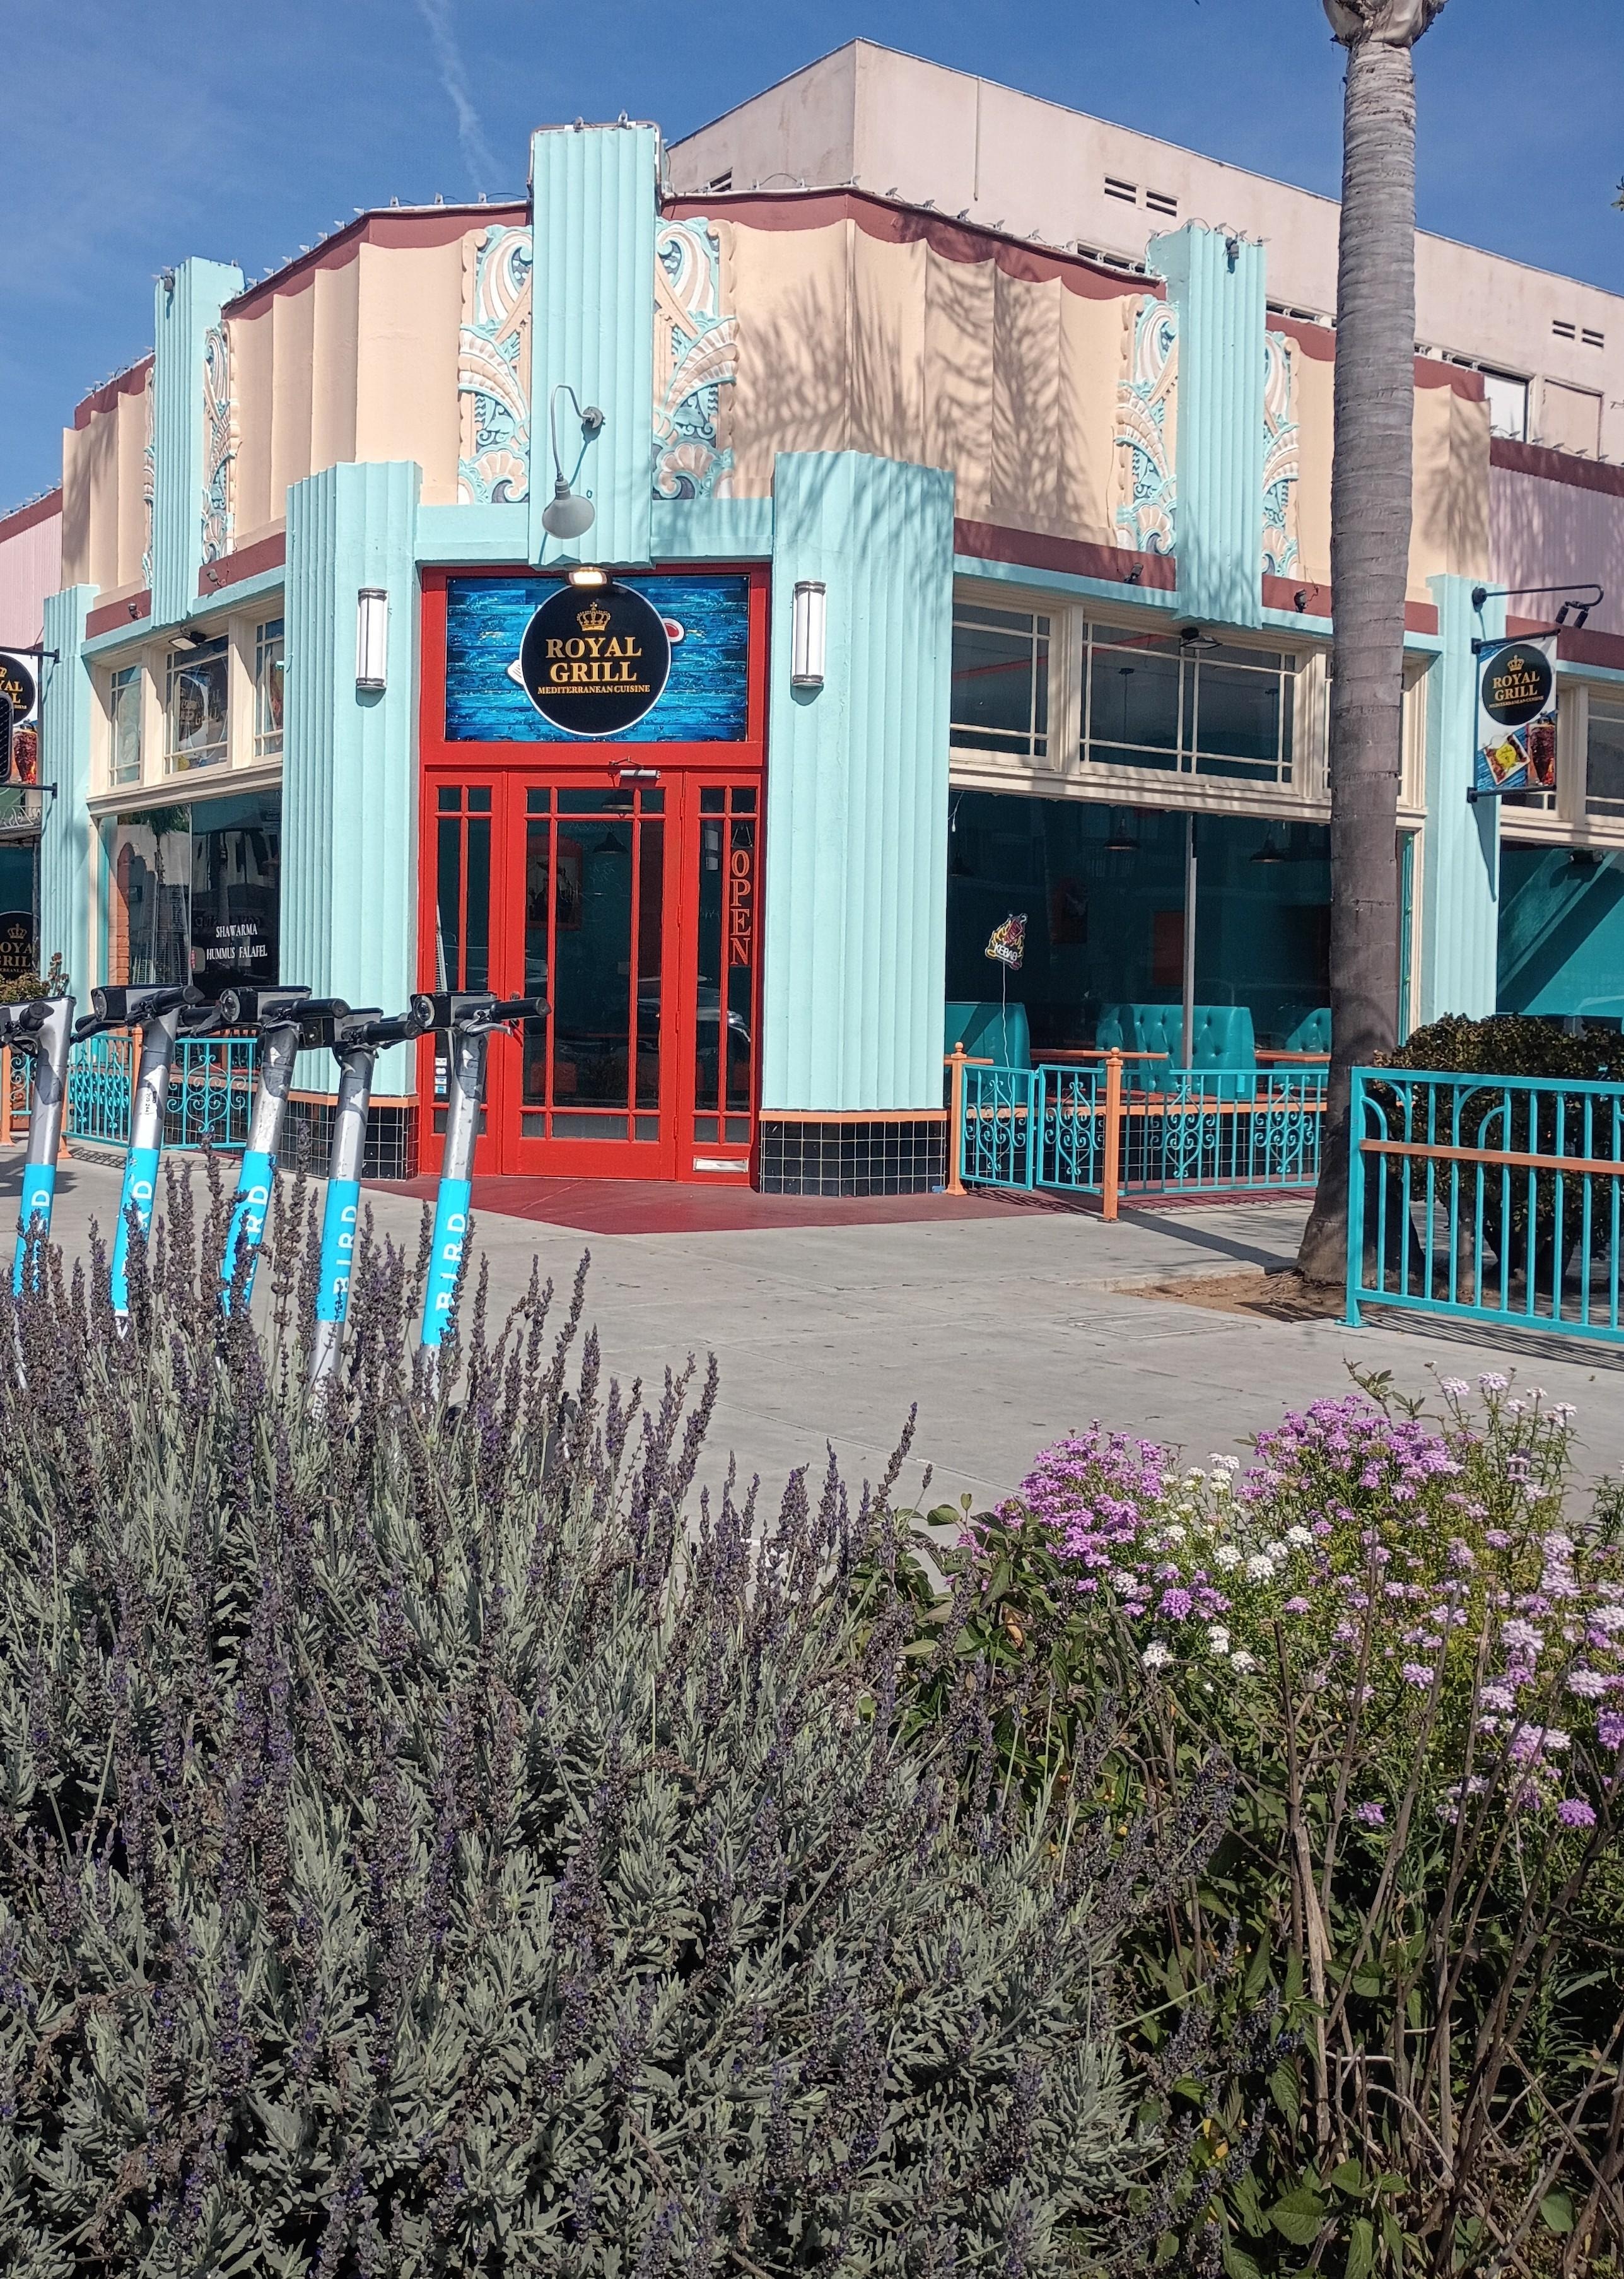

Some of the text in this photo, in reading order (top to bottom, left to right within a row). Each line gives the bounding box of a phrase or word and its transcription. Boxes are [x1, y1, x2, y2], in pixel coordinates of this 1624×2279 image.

[546, 636, 642, 658] ROYAL
[550, 662, 637, 683] GRILL
[1492, 671, 1540, 689] ROYAL
[0, 680, 23, 692] YAL
[538, 684, 650, 694] MEDITERRANEAN CUISINE
[1495, 684, 1538, 701] GRILL
[730, 850, 751, 965] OPEN
[216, 923, 258, 938] SHAWARMA
[0, 941, 33, 954] OYA
[206, 947, 235, 960] HUMMUS
[239, 944, 268, 958] FALAFEL
[994, 942, 1018, 961] KEBAB
[0, 955, 31, 967] RIL
[332, 1205, 358, 1294] BIRD
[435, 1212, 467, 1310] BIRD
